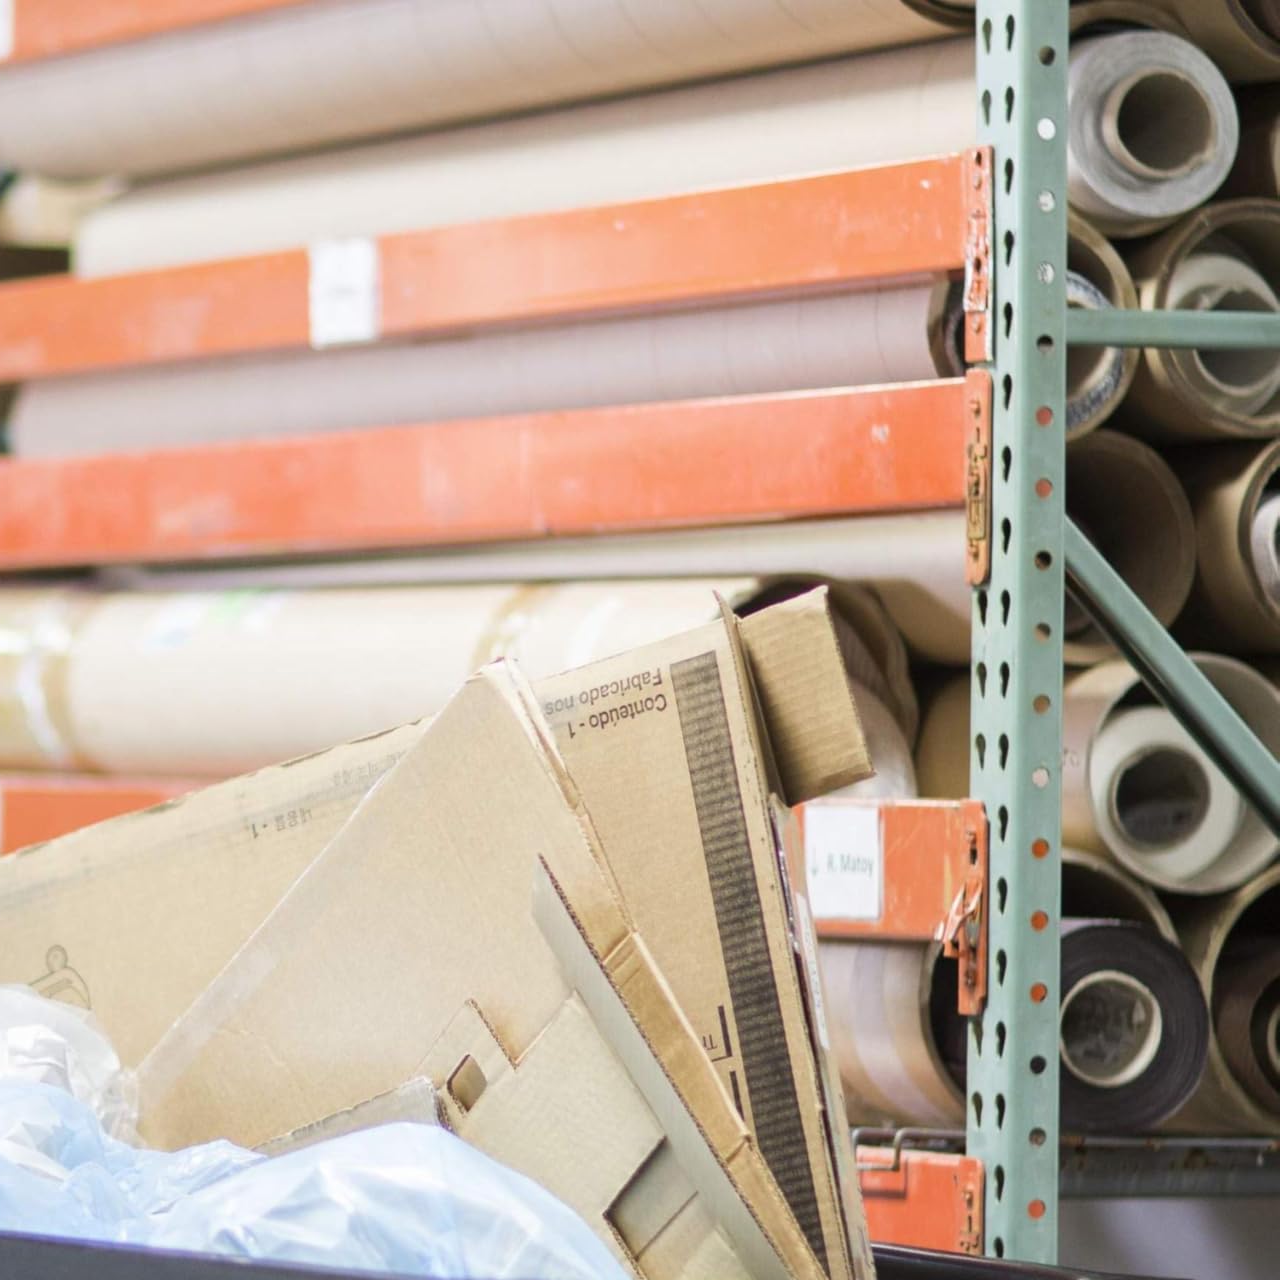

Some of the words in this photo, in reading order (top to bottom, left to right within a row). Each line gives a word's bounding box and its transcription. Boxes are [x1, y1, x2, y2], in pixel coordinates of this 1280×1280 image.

[578, 668, 662, 706] Fabricado
[544, 696, 574, 716] nos
[588, 694, 668, 730] Conteúdo
[568, 722, 576, 738] 1
